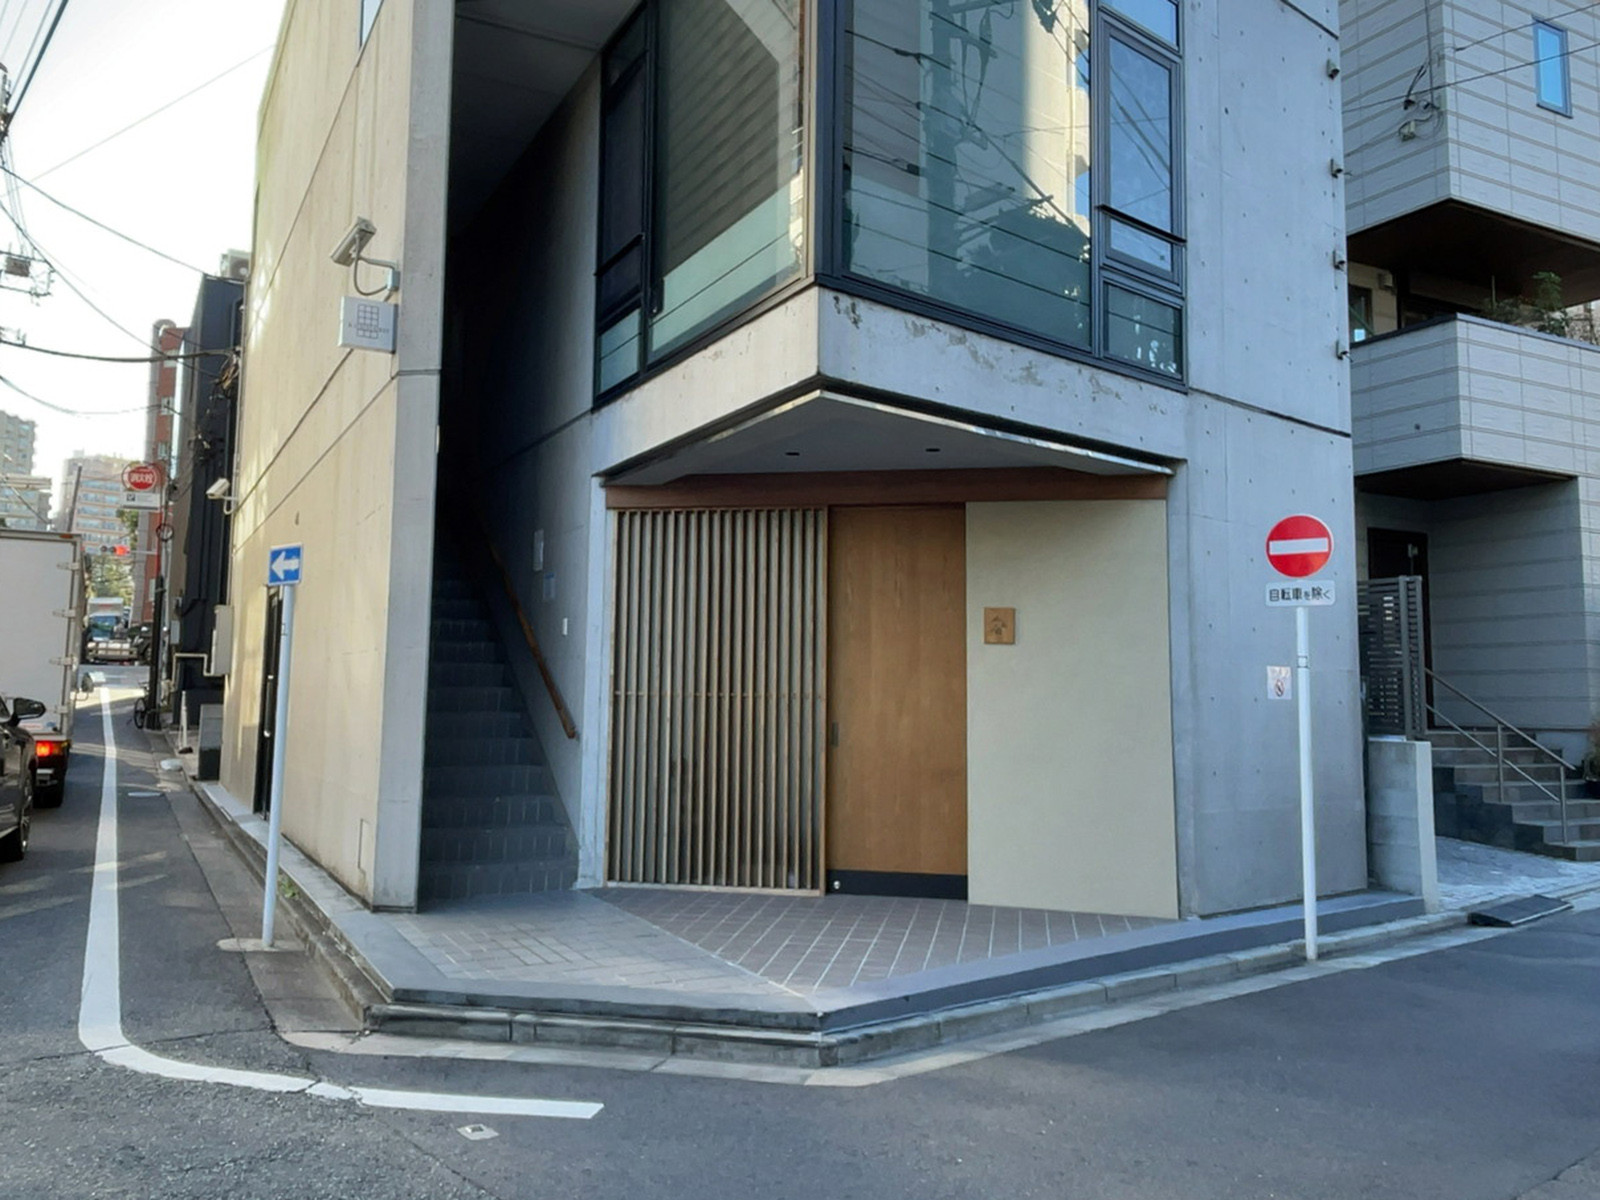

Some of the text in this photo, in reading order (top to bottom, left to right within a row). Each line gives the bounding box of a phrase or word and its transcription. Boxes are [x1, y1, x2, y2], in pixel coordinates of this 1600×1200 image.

[1269, 586, 1331, 601] 自転車を除く
